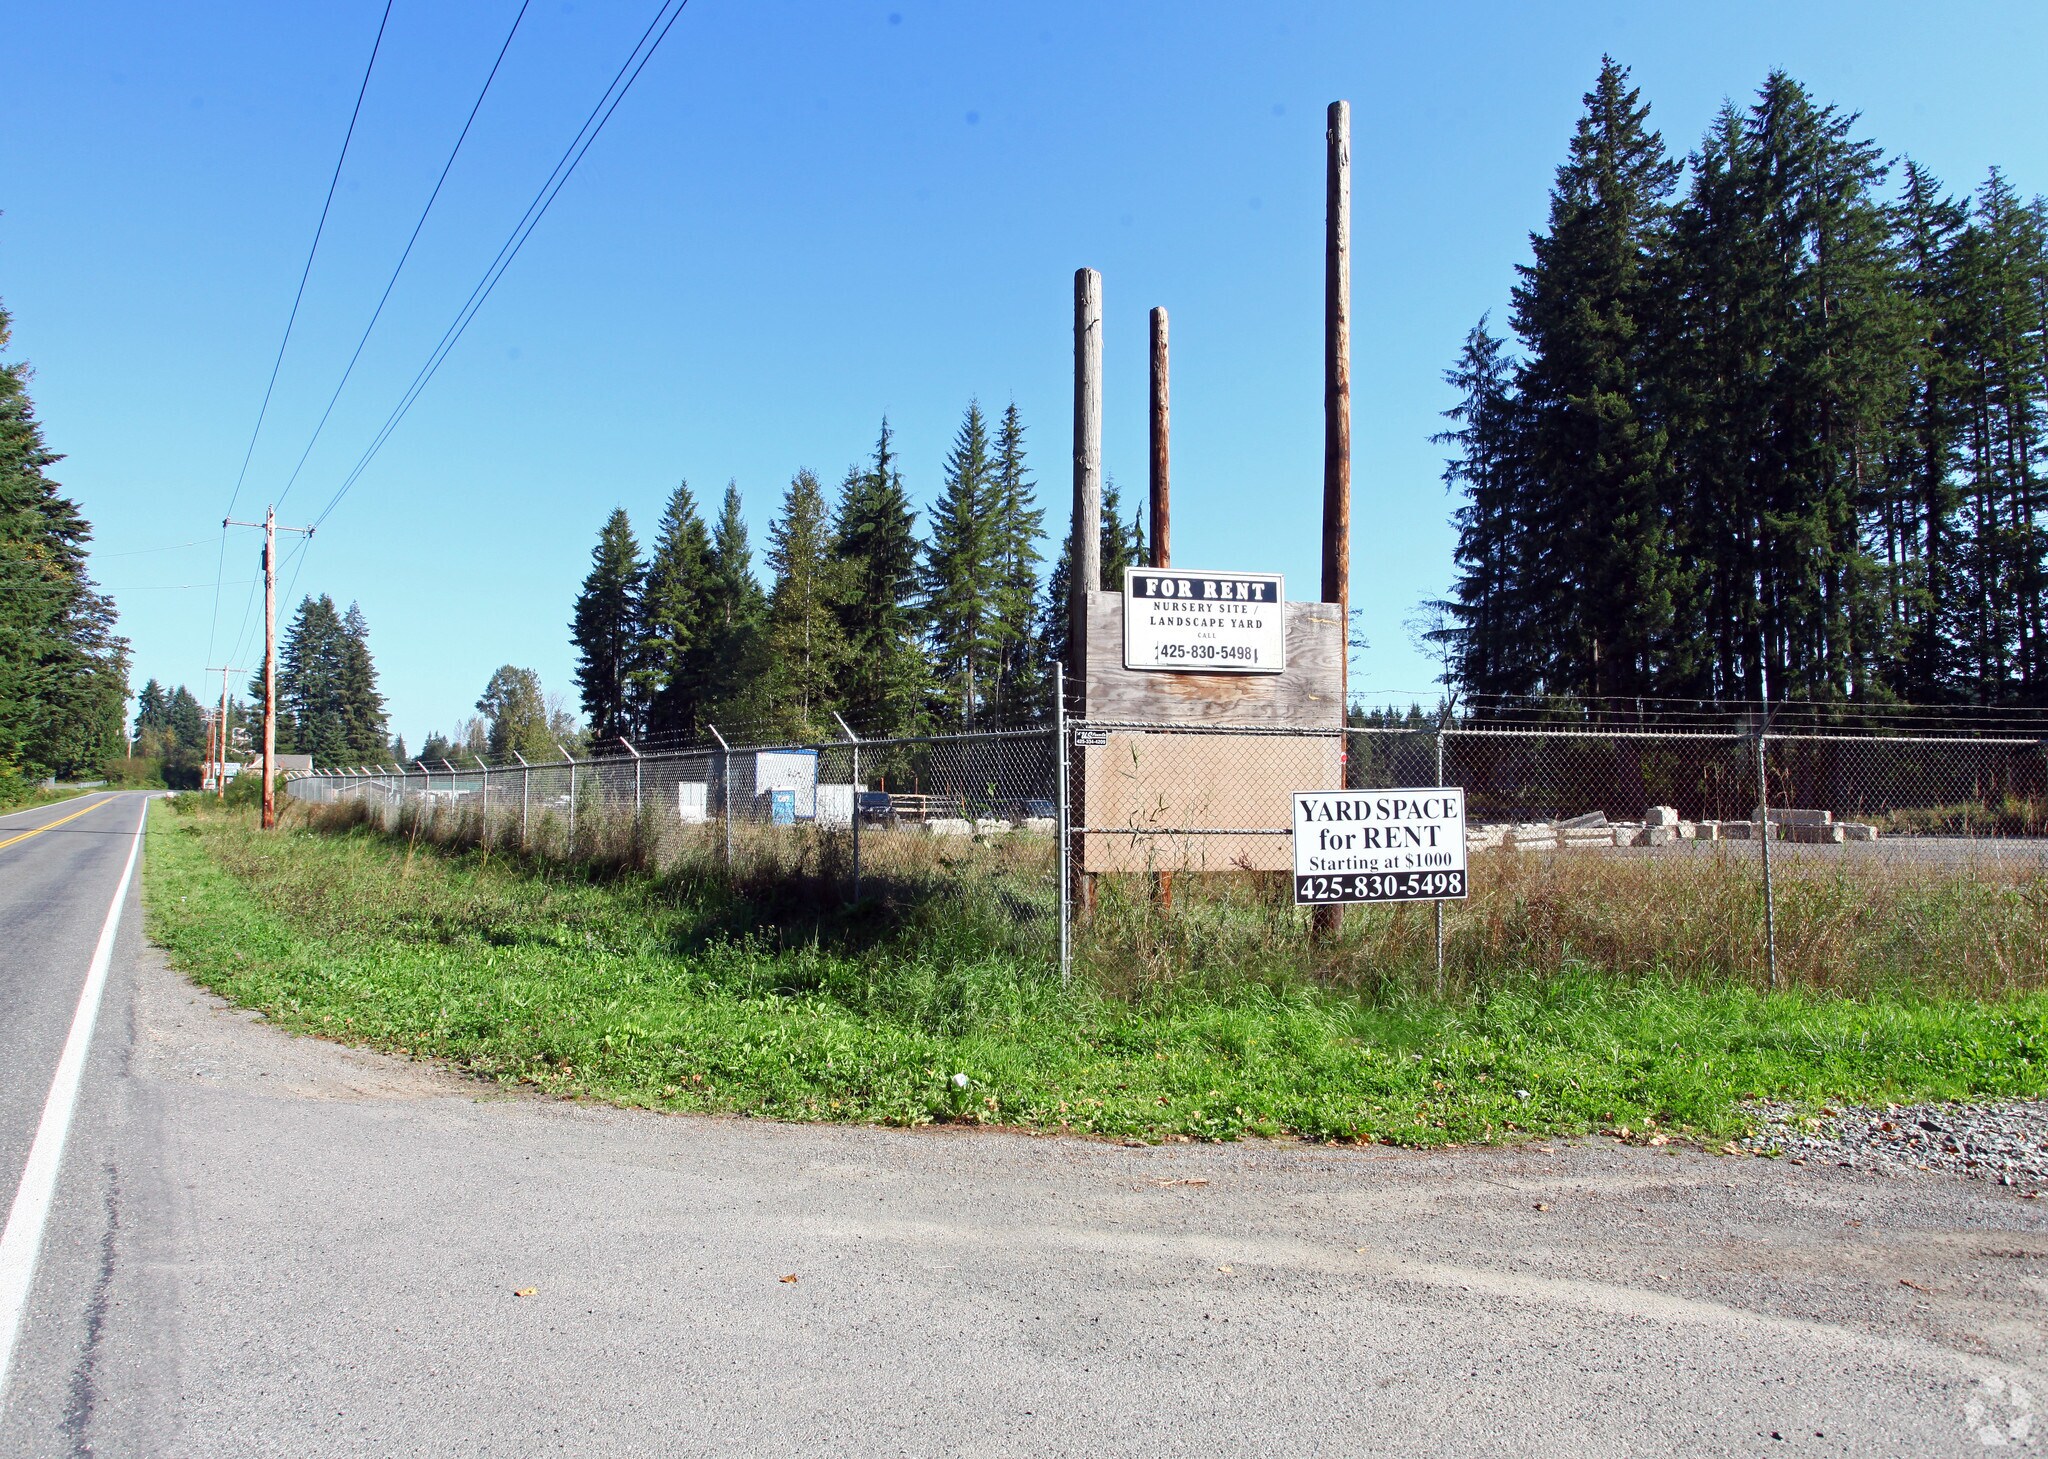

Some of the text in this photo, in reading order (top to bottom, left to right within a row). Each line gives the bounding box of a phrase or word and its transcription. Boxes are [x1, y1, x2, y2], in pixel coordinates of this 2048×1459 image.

[1145, 578, 1265, 600] FOR RENT
[1153, 601, 1212, 612] NURSERY
[1219, 604, 1248, 614] SITE
[1150, 616, 1263, 629] LANDSCAPE YARD
[1160, 644, 1251, 660] 425-830-5498
[1300, 798, 1458, 822] YARD SPACE
[1319, 825, 1441, 850] for RENT
[1309, 852, 1452, 873] Starting at $1000
[1300, 872, 1462, 899] 425-830-5498
